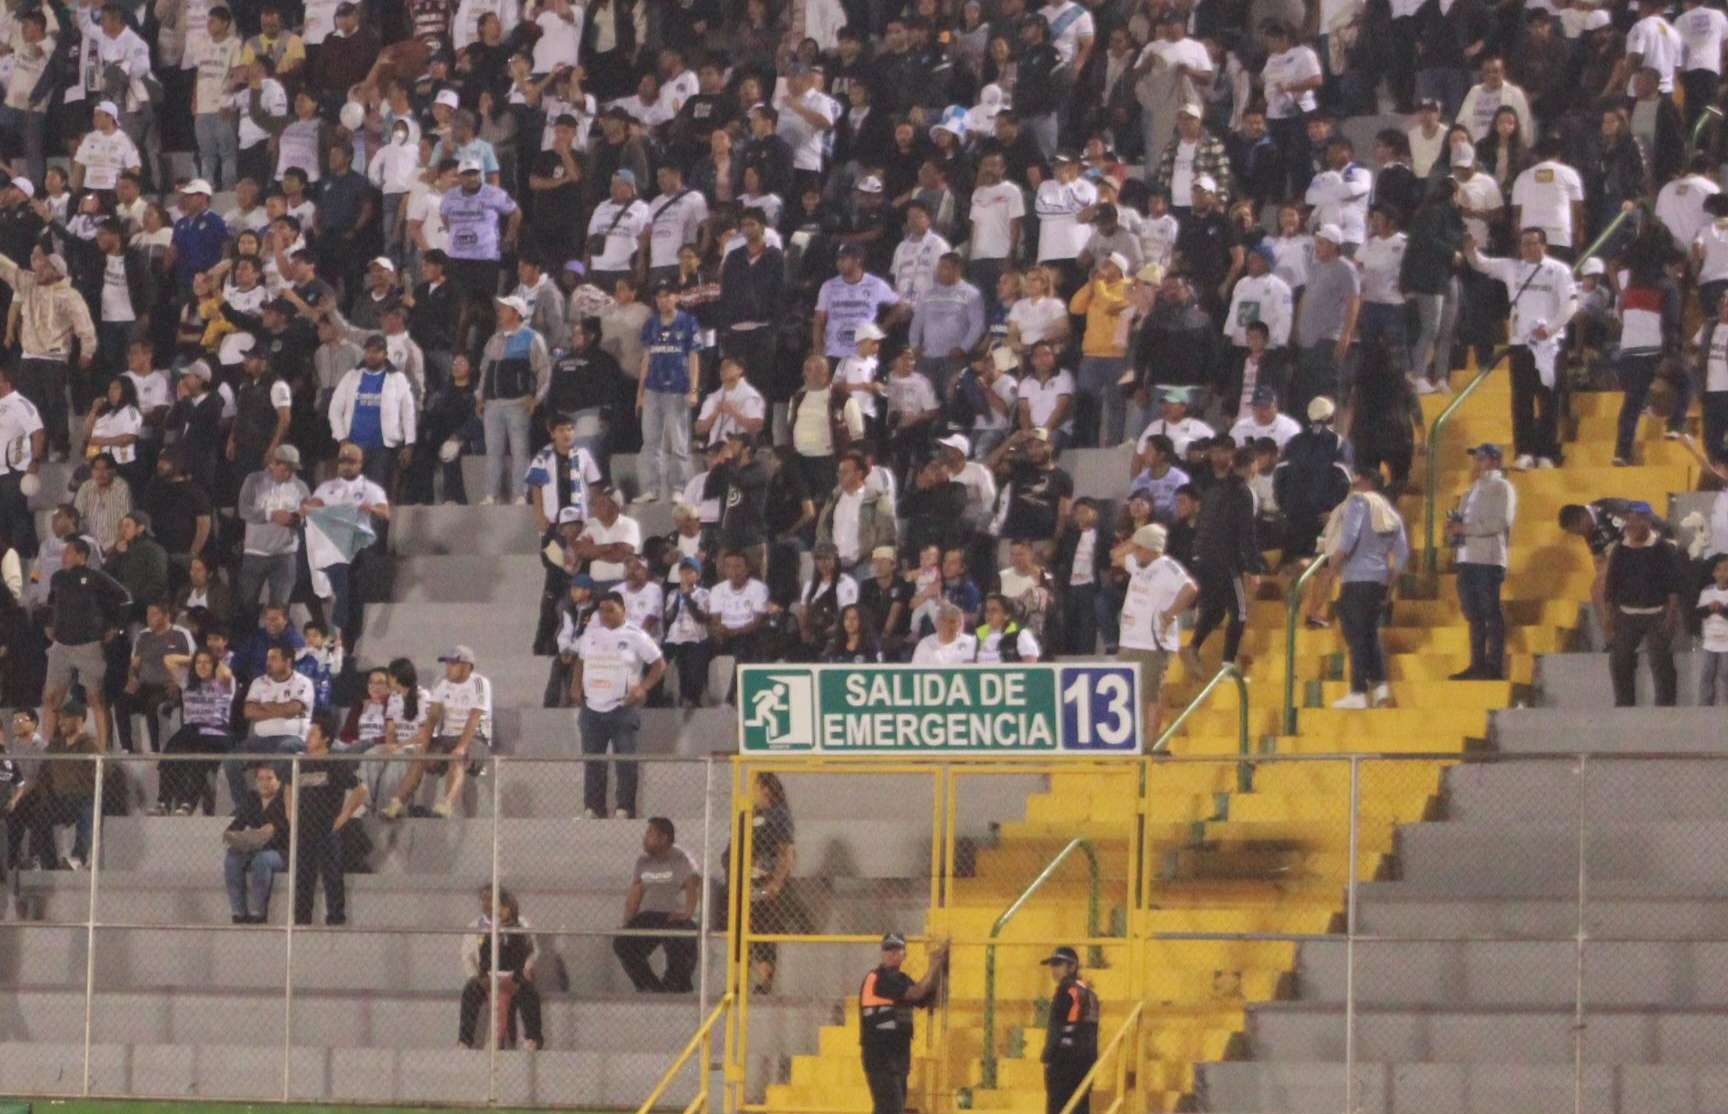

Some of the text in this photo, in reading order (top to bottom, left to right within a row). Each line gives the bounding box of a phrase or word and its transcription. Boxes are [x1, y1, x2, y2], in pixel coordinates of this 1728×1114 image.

[845, 673, 1025, 707] SALIDA DE
[1063, 672, 1133, 745] 13
[823, 712, 1053, 747] EMERGENCIA
